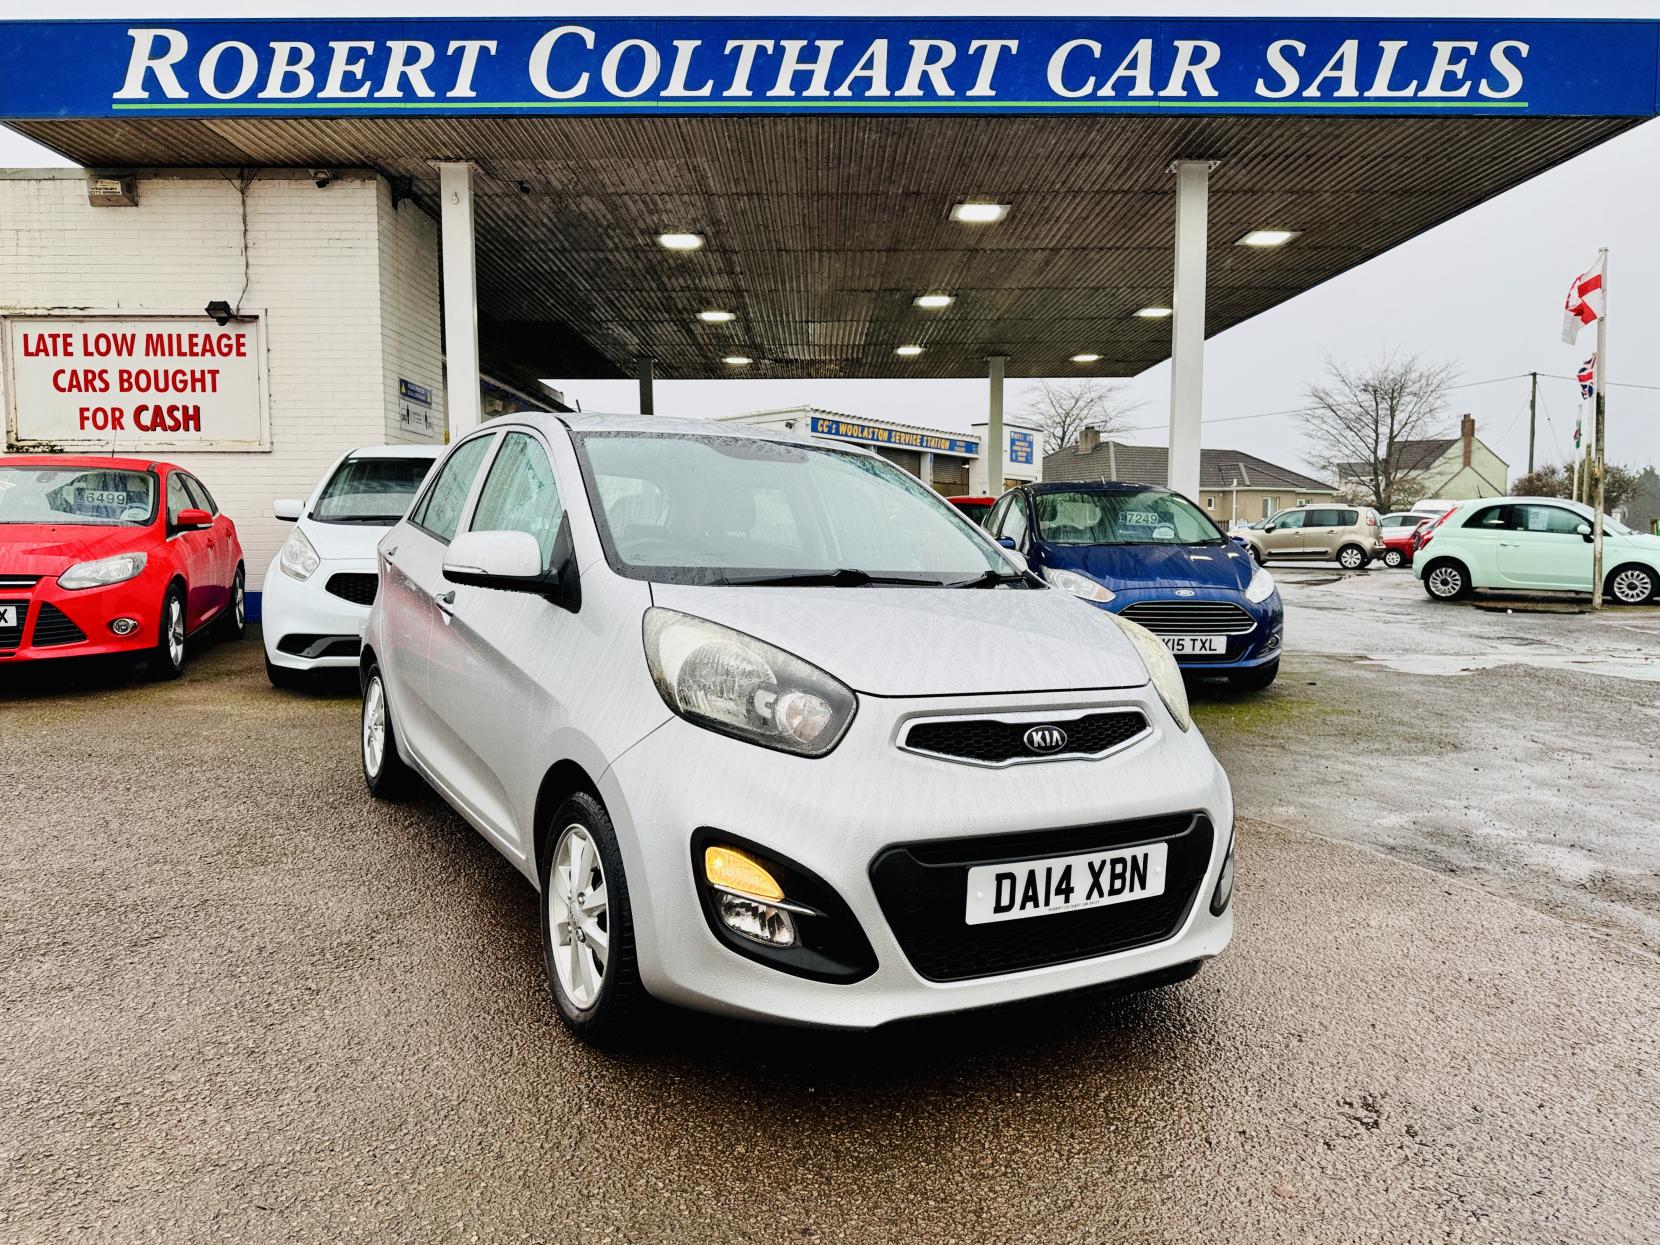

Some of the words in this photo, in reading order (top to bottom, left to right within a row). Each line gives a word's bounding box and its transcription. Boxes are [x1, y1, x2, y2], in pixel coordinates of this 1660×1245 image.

[113, 28, 498, 99] ROBERT
[528, 25, 1019, 100] COLTHART
[1047, 38, 1221, 98] CAR
[1255, 39, 1530, 100] SALES
[22, 332, 74, 358] LATE
[82, 332, 136, 358] LOW
[144, 332, 247, 358] MILEAGE
[52, 368, 111, 393] CARS
[118, 368, 220, 394] BOUGHT
[78, 406, 125, 431] FOR
[132, 404, 202, 432] CASH
[840, 422, 888, 441] WOOLASTON
[891, 430, 921, 446] SERVICE
[922, 434, 950, 450] STATION
[86, 492, 125, 505] 6499
[1190, 638, 1217, 652] TXL
[1031, 730, 1063, 748] KIA
[993, 864, 1075, 914] DA14
[1085, 852, 1149, 901] XBN
